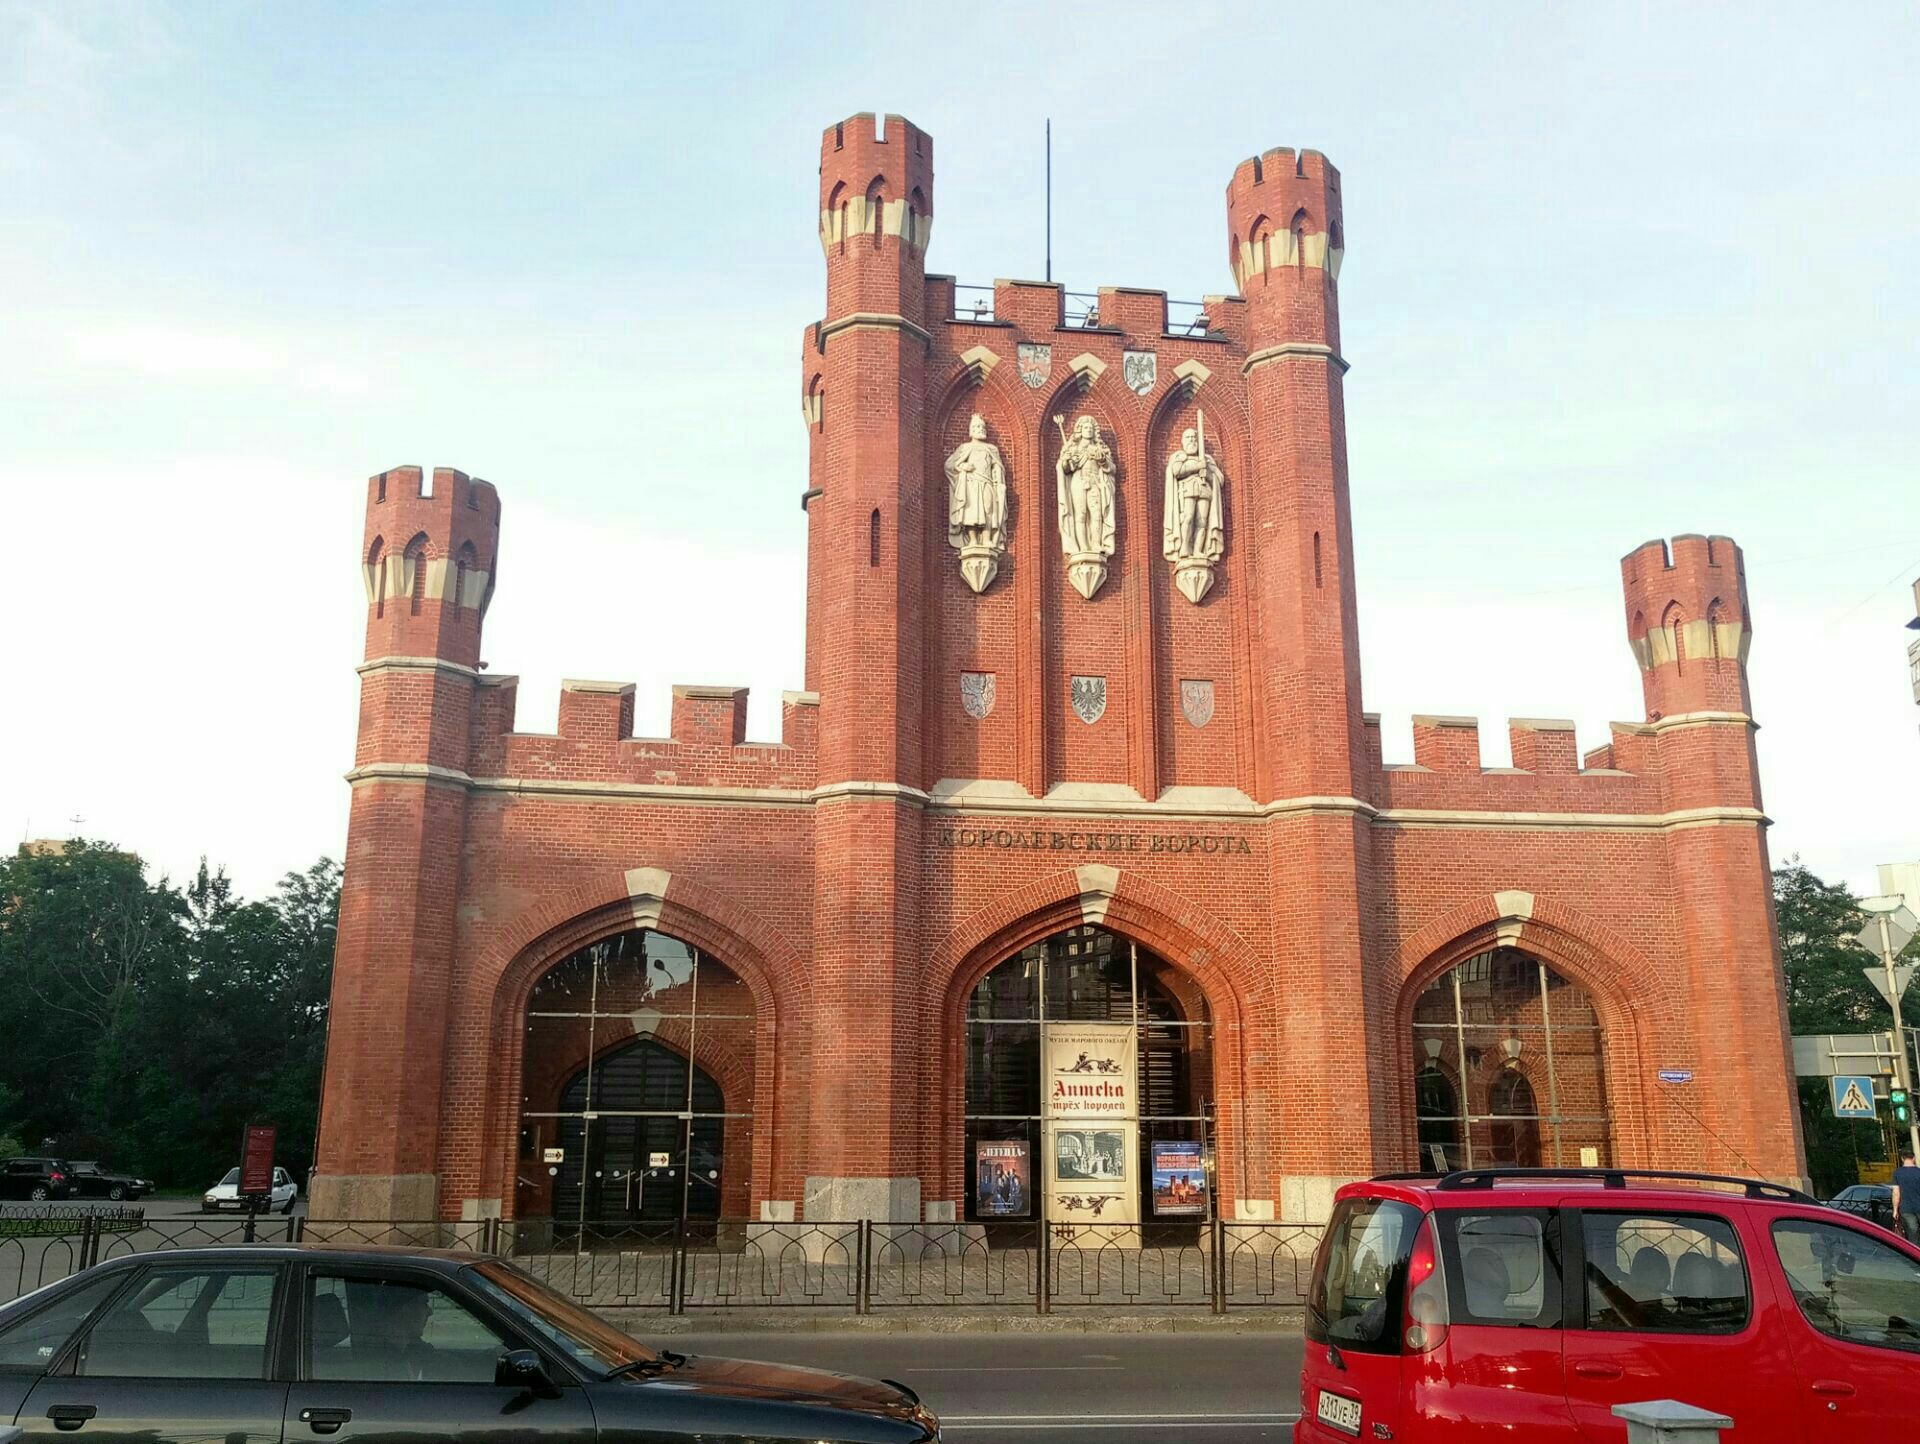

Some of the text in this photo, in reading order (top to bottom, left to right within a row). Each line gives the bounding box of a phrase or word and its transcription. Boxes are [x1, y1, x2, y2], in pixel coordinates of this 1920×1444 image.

[938, 828, 1252, 855] КОРОЛЕВСКИЕ ВОРОТА
[1052, 1079, 1125, 1101] Аптека
[1053, 1100, 1126, 1112] трёх королей
